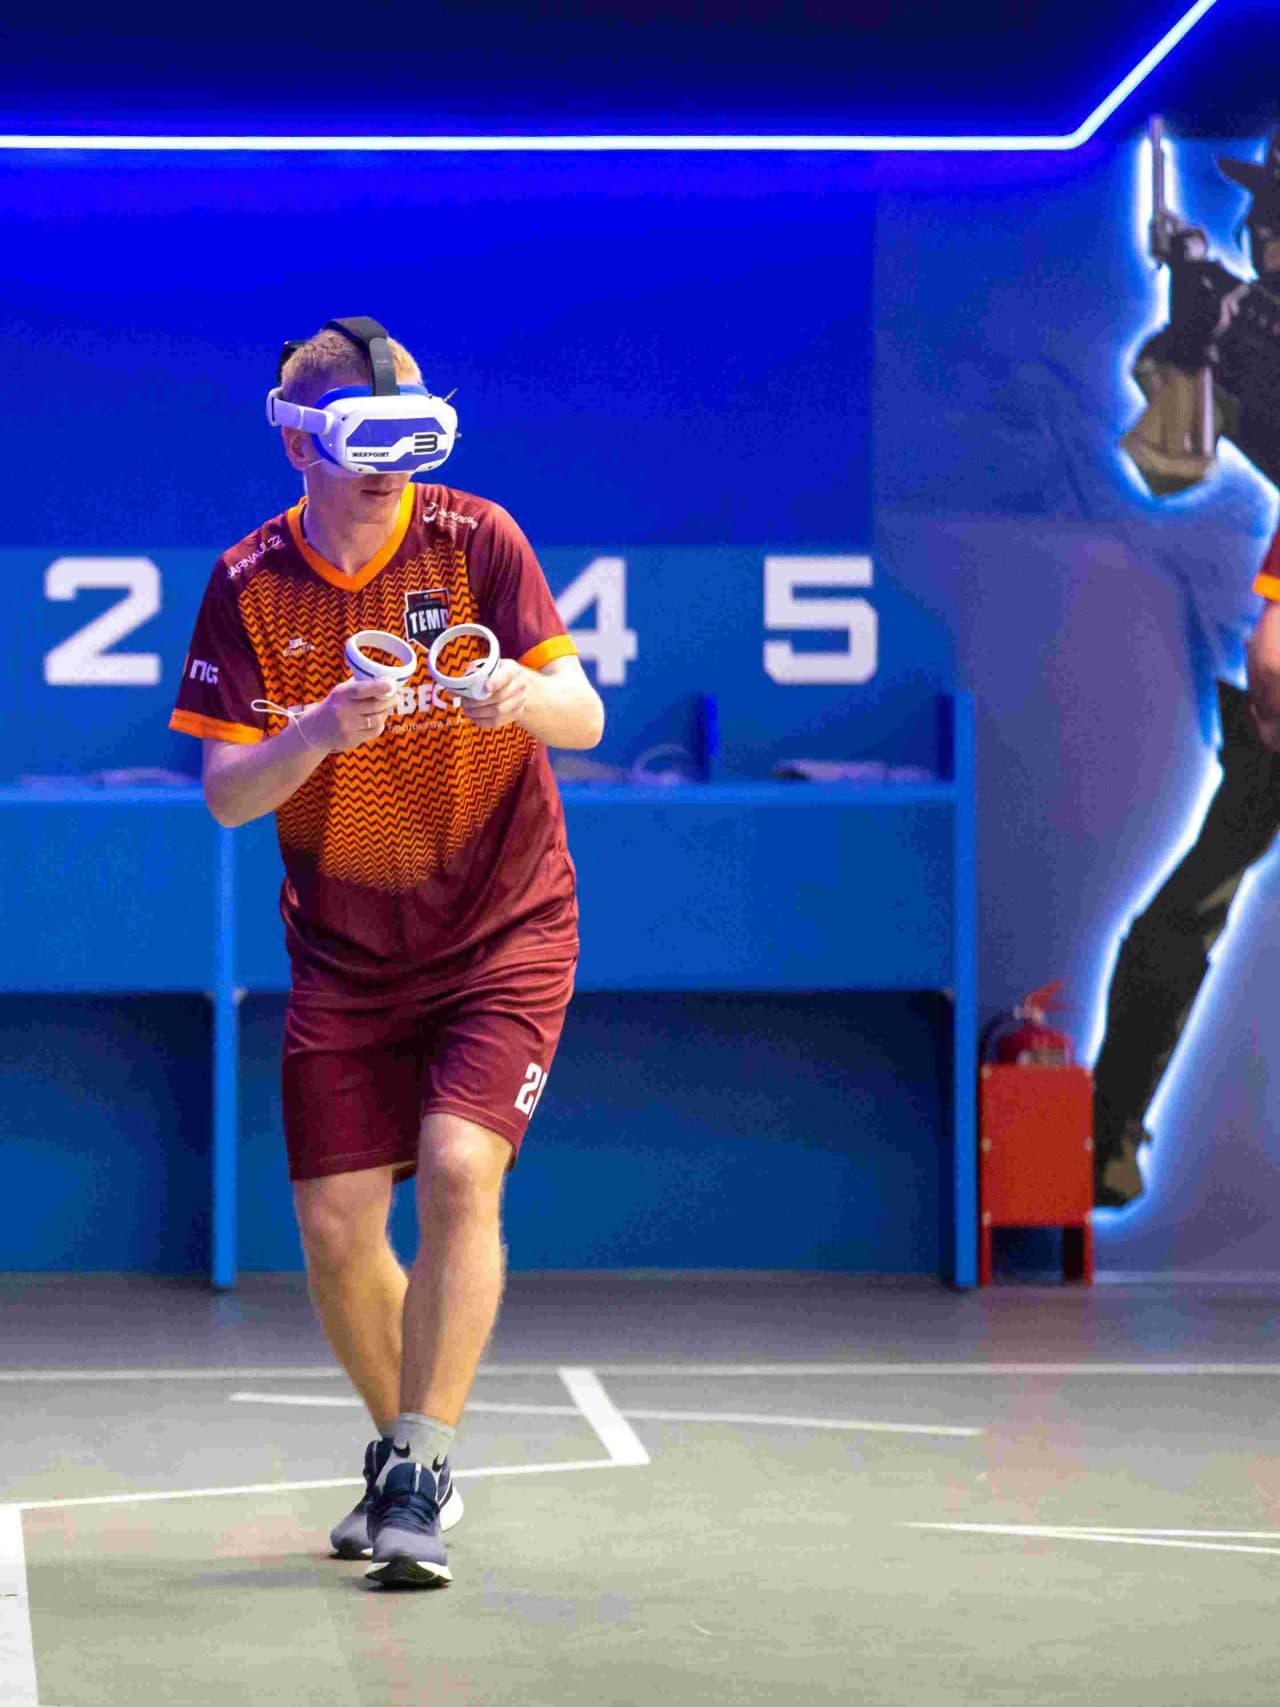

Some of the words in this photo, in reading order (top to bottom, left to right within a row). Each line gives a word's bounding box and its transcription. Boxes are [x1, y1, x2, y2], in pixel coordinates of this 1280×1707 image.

[414, 433, 438, 454] 3
[45, 557, 161, 686] 2
[555, 556, 638, 685] 4
[763, 556, 879, 685] 5
